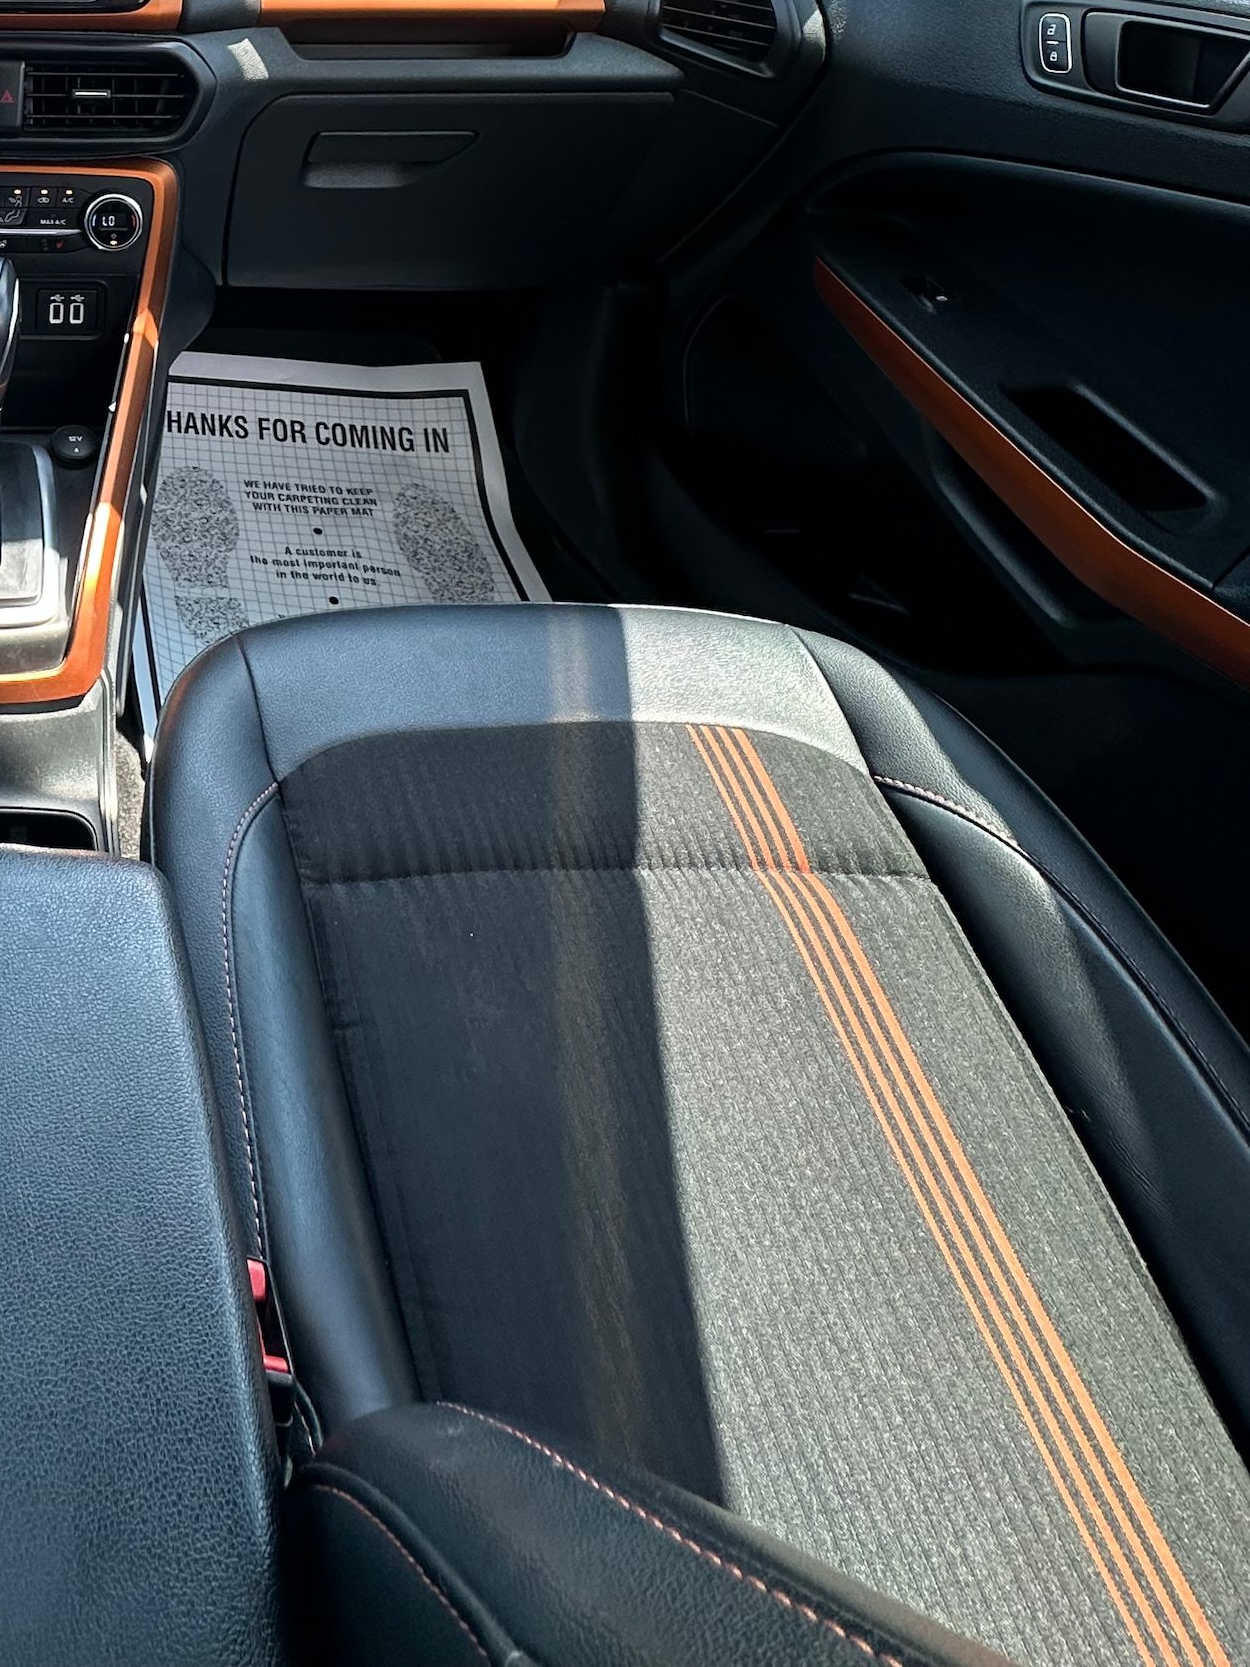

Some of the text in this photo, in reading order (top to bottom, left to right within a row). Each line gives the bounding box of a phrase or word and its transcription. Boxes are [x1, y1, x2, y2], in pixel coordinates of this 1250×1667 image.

[55, 218, 66, 226] A/C
[102, 216, 116, 227] LO
[166, 410, 450, 454] HANKS FOR COMING IN
[243, 479, 374, 496] WE HAVE TRIED TO KEEP
[244, 490, 378, 506] YOUR CARPETING CLEAN
[252, 502, 374, 516] WITH THIS PAPER MAT
[284, 546, 362, 559] A customer is
[250, 555, 401, 577] the most important person
[276, 570, 287, 579] in
[290, 570, 309, 580] the
[312, 572, 345, 582] world
[348, 573, 360, 584] to
